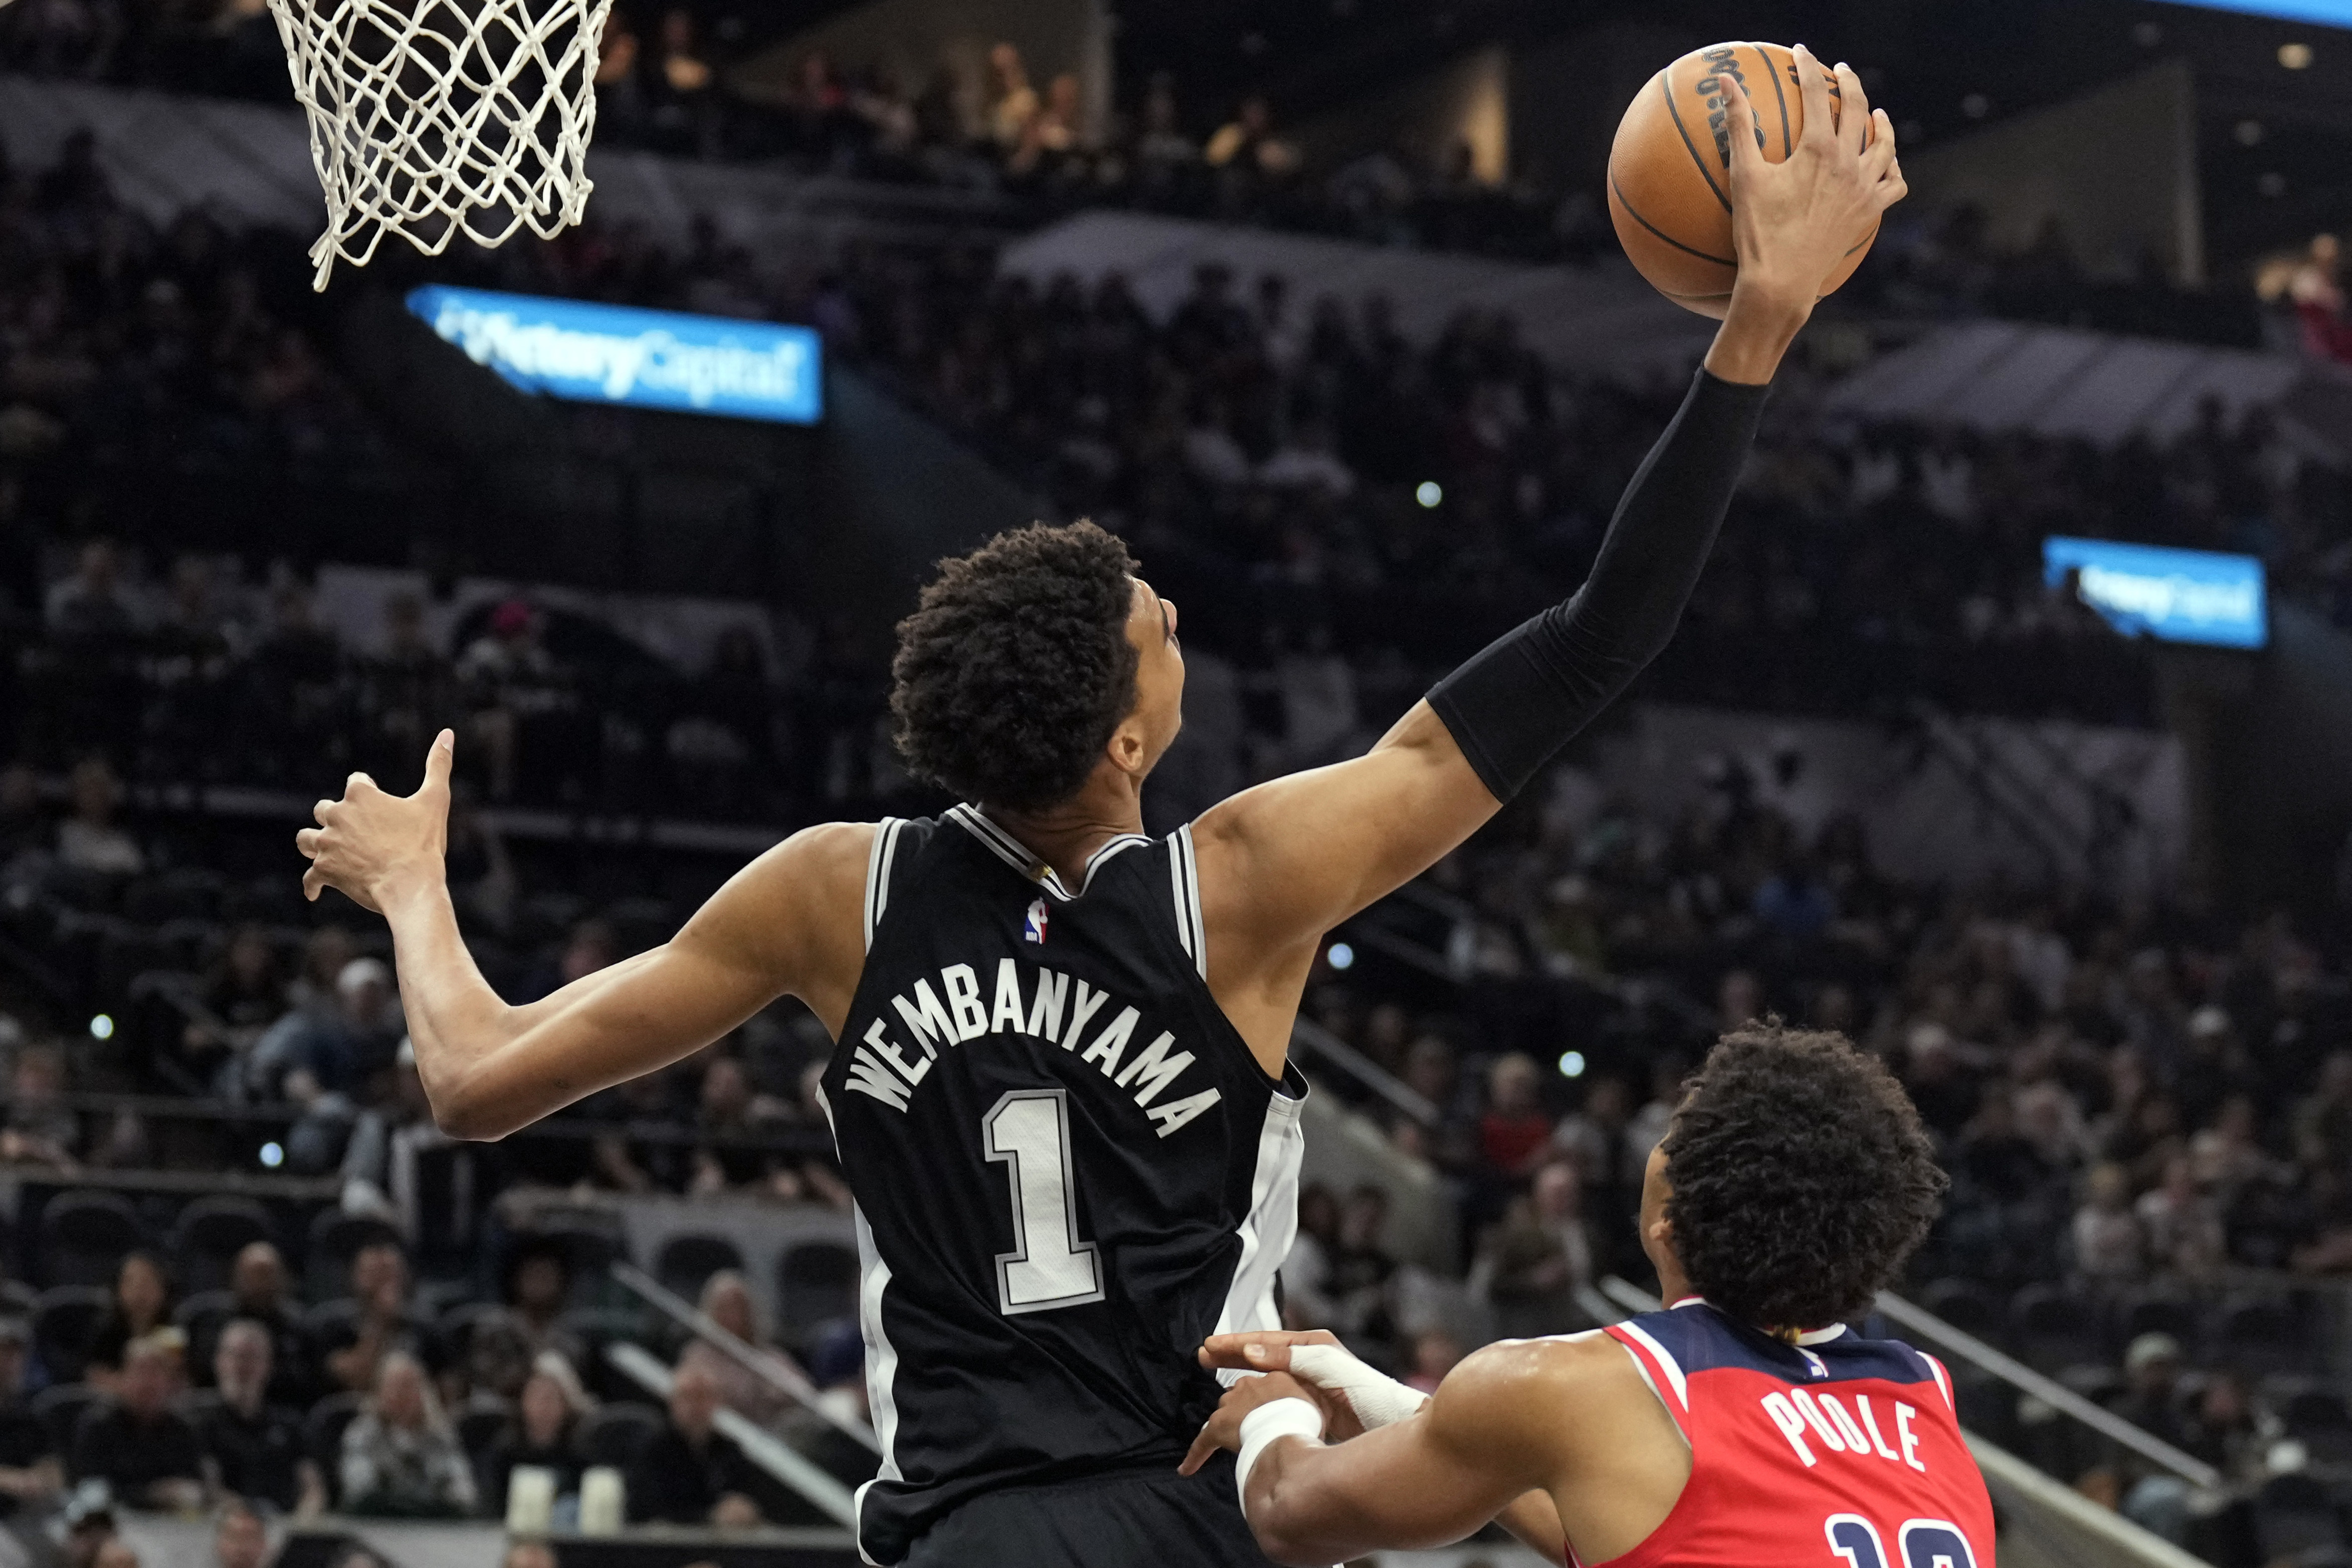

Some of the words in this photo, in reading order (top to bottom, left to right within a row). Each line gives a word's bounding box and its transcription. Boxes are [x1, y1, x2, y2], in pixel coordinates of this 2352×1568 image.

[845, 958, 1222, 1139] WEMBANYAMA
[982, 1088, 1106, 1316] 1
[1760, 1388, 1926, 1473] POOLE
